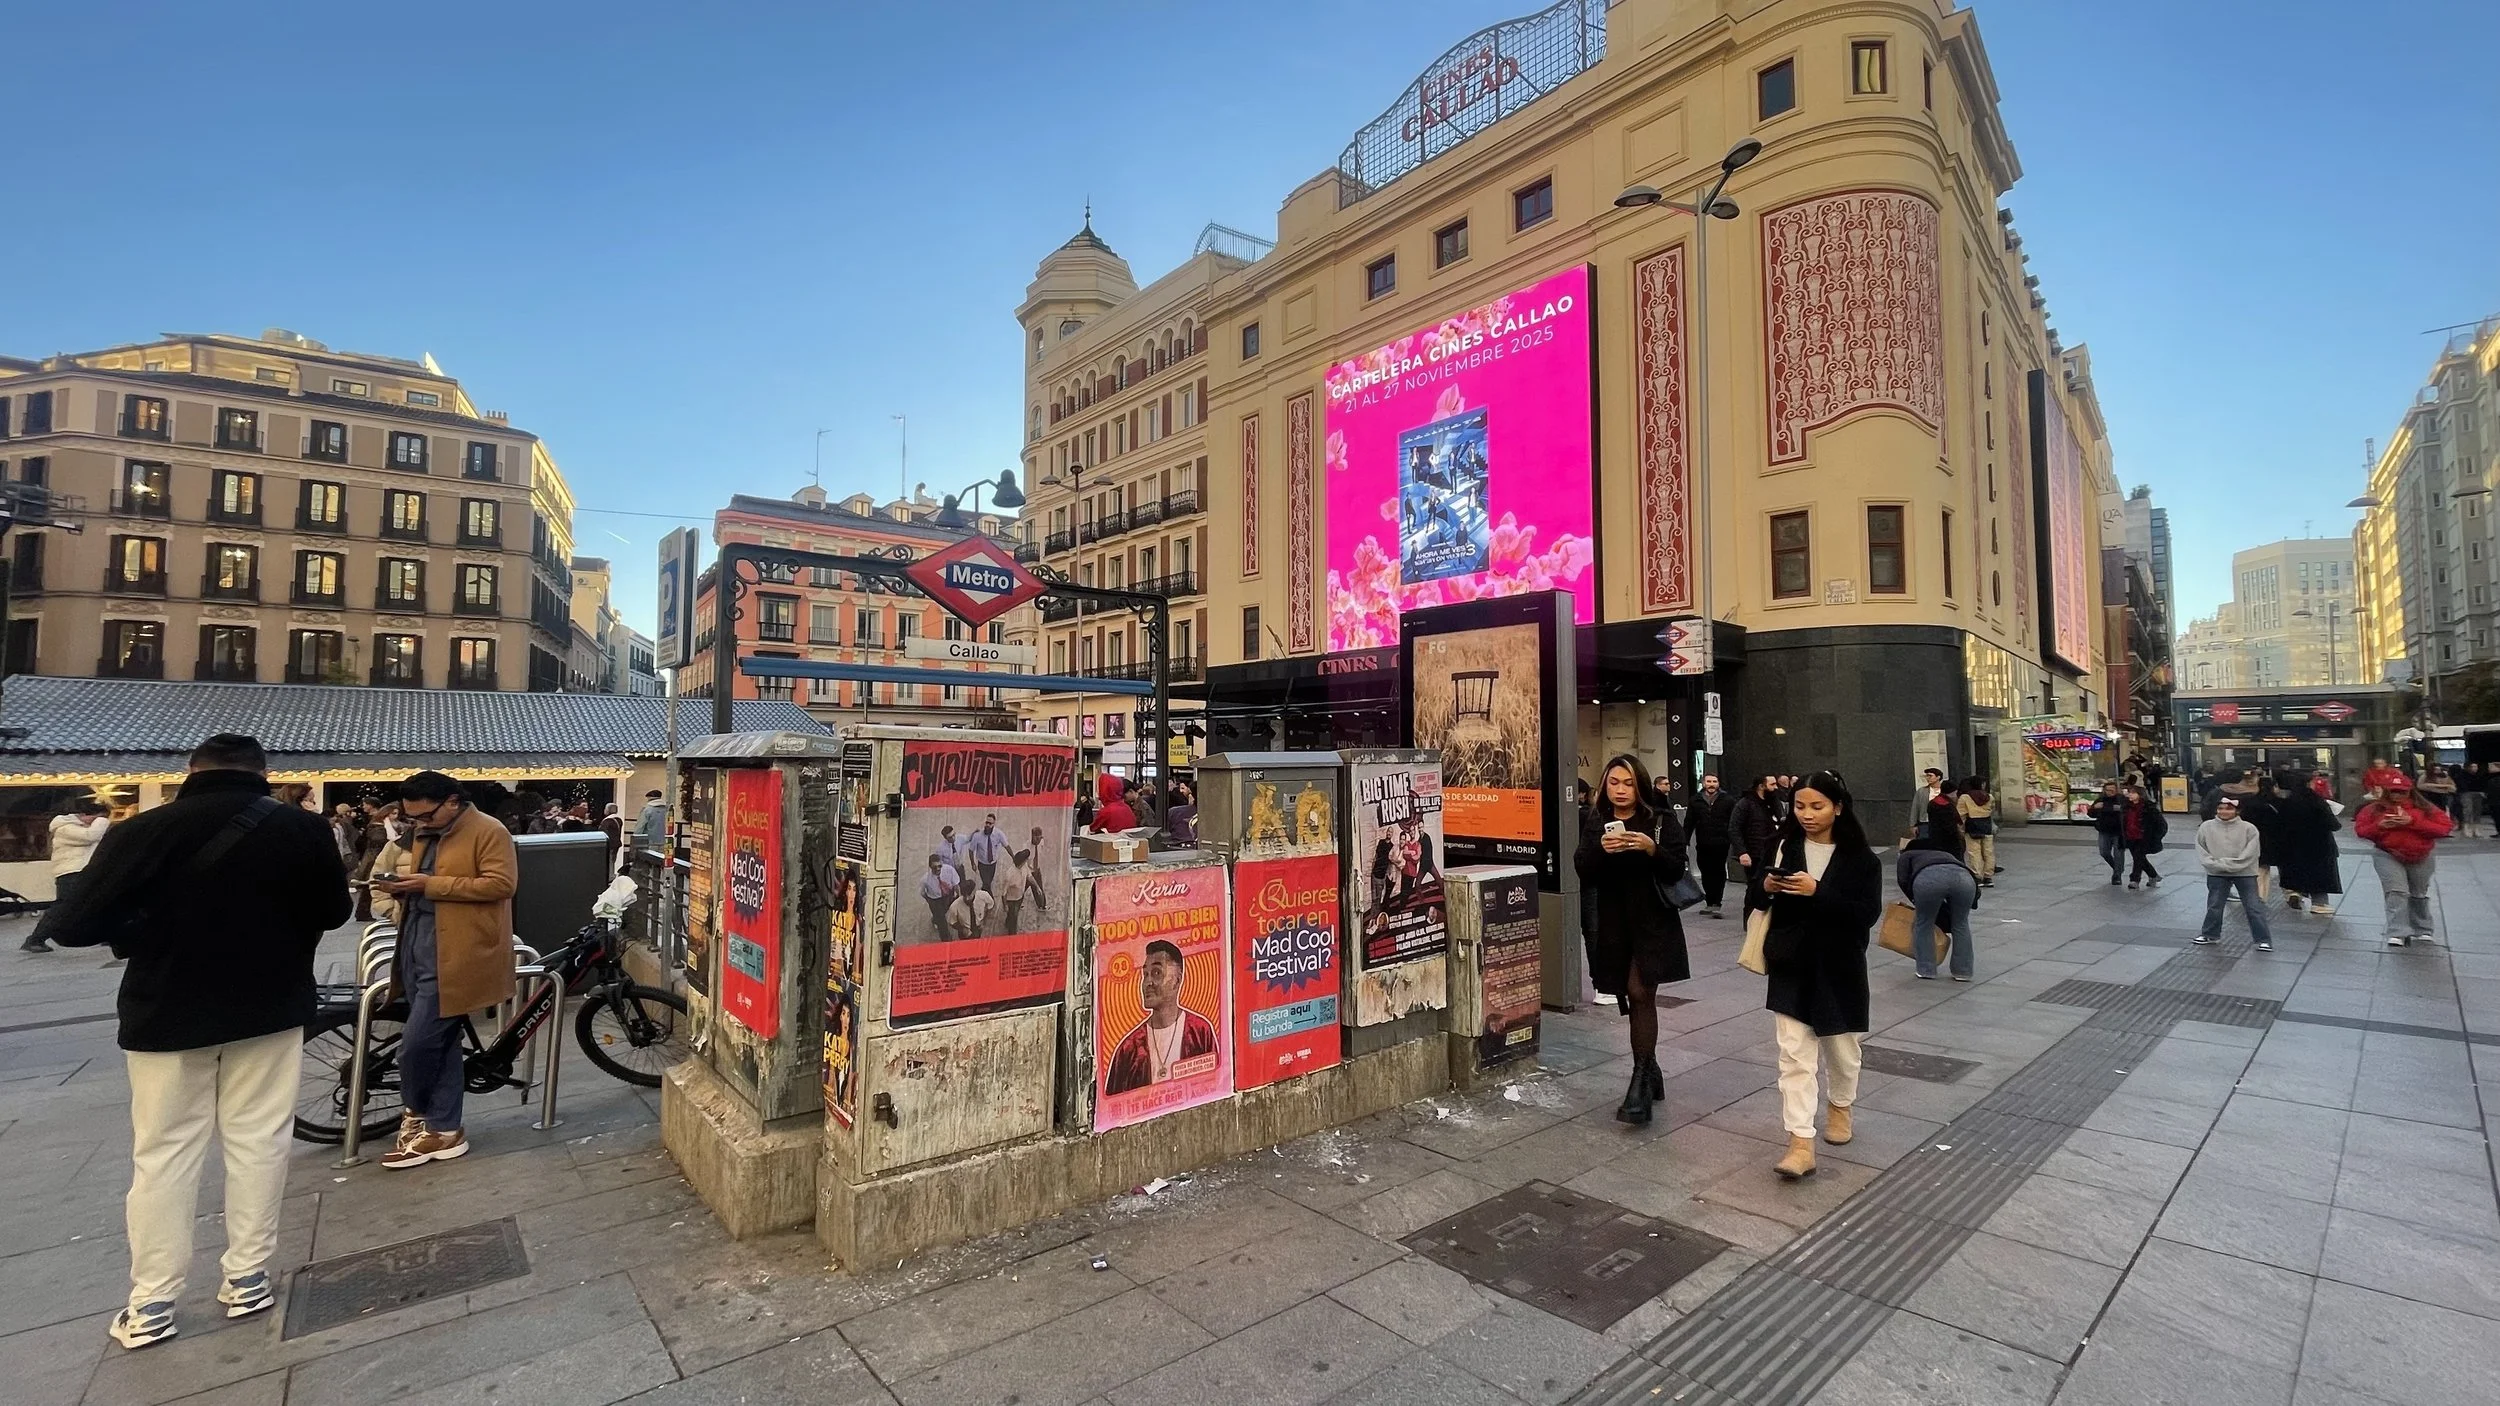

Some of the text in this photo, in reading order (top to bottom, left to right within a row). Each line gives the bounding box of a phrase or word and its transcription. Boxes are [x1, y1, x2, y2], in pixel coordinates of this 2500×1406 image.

[1421, 45, 1493, 104] CINES
[1402, 57, 1518, 142] CALLAO
[1331, 295, 1574, 399] CARTELERA CINES CALLAO
[1345, 325, 1554, 413] 21 AL 27 NOVIEMBRE 2025
[1466, 543, 1476, 556] 3
[952, 565, 1009, 589] Metro
[949, 644, 999, 659] Callao
[1317, 656, 1378, 676] CINES
[1362, 776, 1382, 802] BIG
[1382, 773, 1410, 799] TIME
[1452, 793, 1461, 801] DE
[1463, 793, 1499, 803] SOLEDAD
[1381, 797, 1409, 823] RUSH
[1431, 796, 1441, 806] LIFE
[733, 831, 752, 853] tocar
[1506, 845, 1536, 855] MADRID
[731, 852, 767, 884] Mad Cool
[731, 877, 765, 910] Festival?
[1132, 879, 1189, 904] Karim
[1249, 879, 1337, 917] ¿Quieres
[1508, 894, 1528, 905] COOL
[1098, 905, 1219, 943] TODO VA A IR BIEN
[1203, 925, 1219, 940] NO
[1257, 910, 1329, 935] tocar en
[1252, 924, 1335, 959] Mad Cool
[1256, 948, 1331, 981] Festival?
[1252, 1001, 1312, 1025] Registra aquí
[1252, 1020, 1293, 1038] tu banda
[1143, 1096, 1163, 1110] HACE
